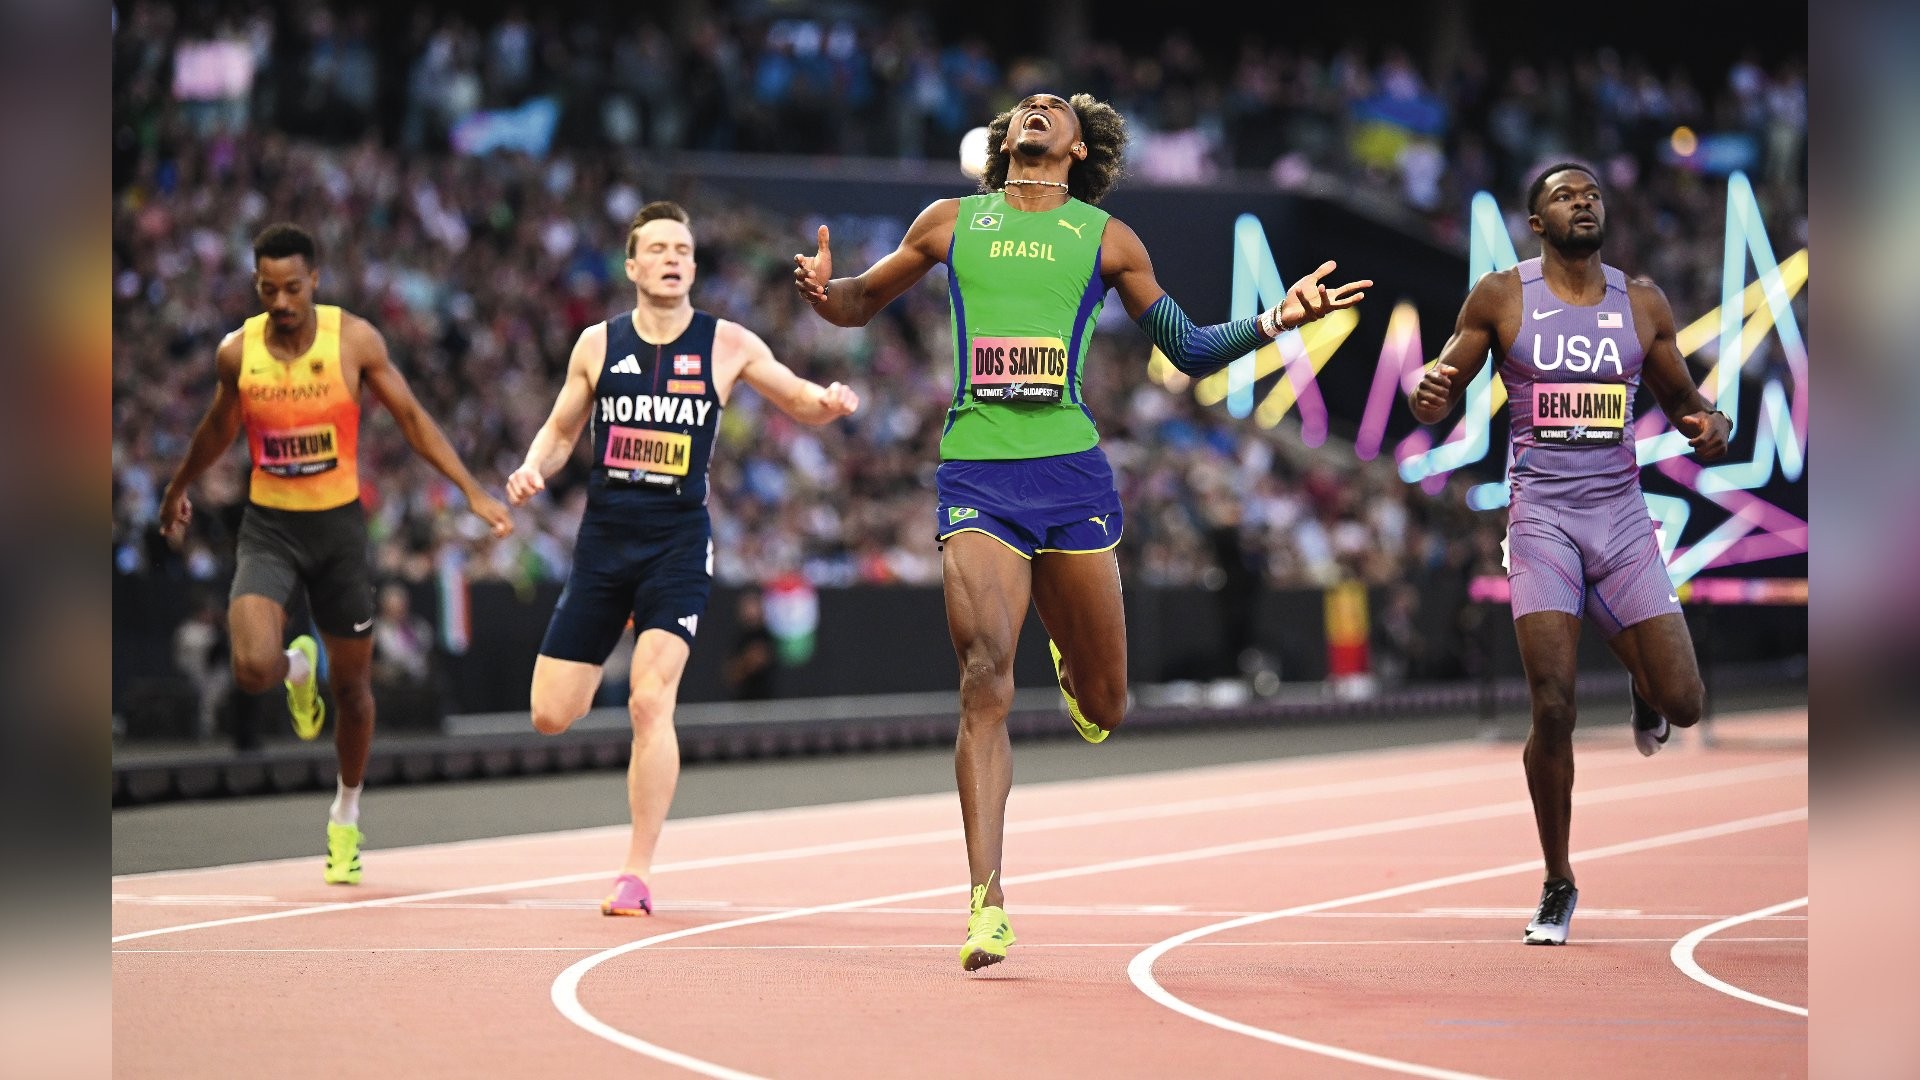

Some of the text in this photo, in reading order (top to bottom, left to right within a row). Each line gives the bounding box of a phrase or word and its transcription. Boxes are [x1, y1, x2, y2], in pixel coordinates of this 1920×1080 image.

[989, 240, 1056, 262] BRASIL
[975, 346, 1066, 377] DOS SANTOS
[1533, 333, 1623, 375] USA
[976, 388, 1004, 397] ULTIMATE
[1023, 387, 1053, 397] BUDAPEST
[1538, 392, 1622, 419] BENJAMIN
[600, 394, 712, 427] NORWAY
[610, 436, 685, 466] WARHOLM
